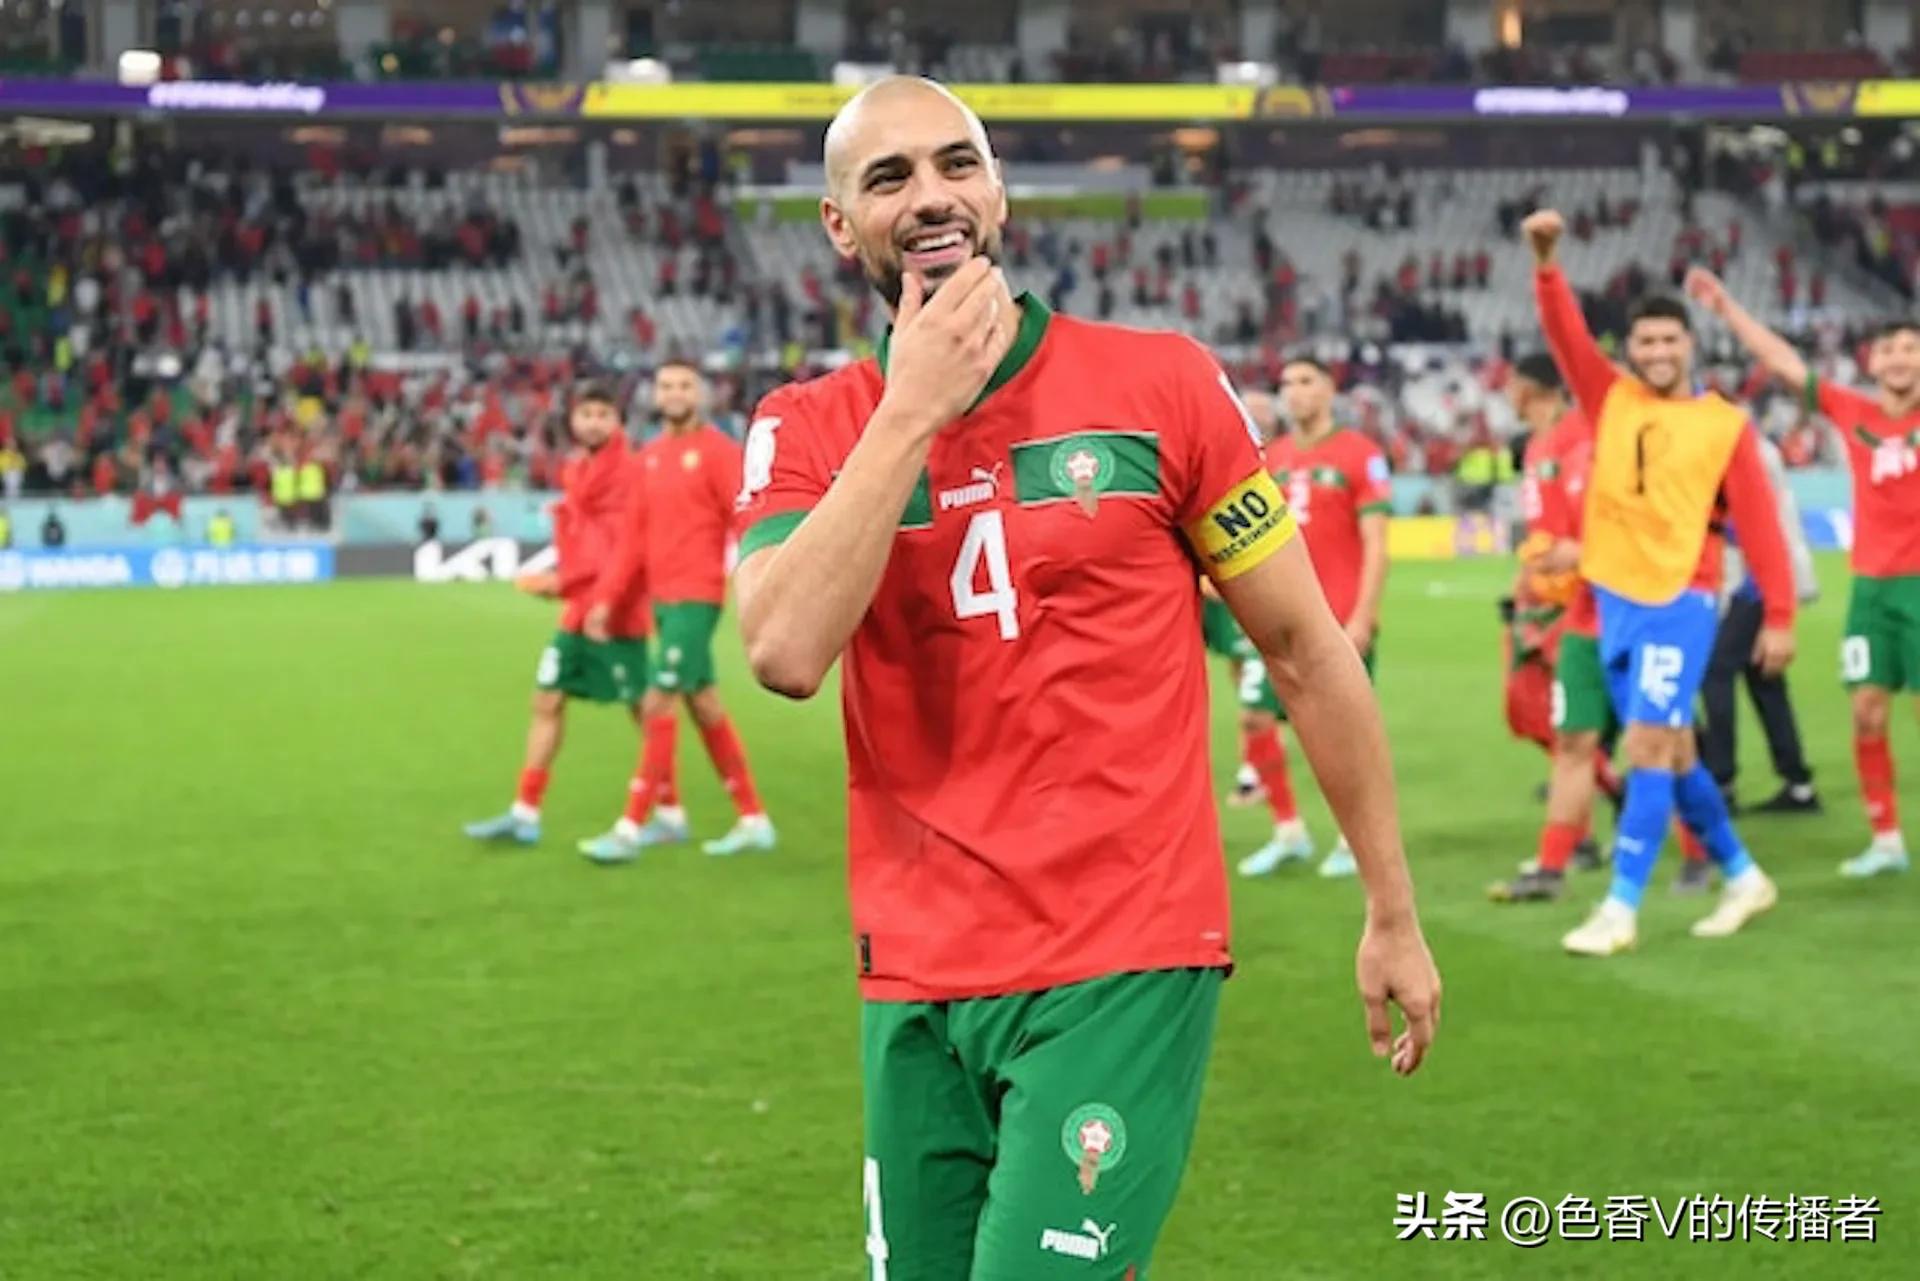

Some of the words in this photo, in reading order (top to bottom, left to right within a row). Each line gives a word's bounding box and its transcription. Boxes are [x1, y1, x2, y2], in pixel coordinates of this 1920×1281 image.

[939, 482, 995, 511] PUMA
[1213, 490, 1269, 537] NO
[950, 509, 1020, 641] 4
[1640, 643, 1684, 711] 12
[1040, 1228, 1099, 1261] PUMA
